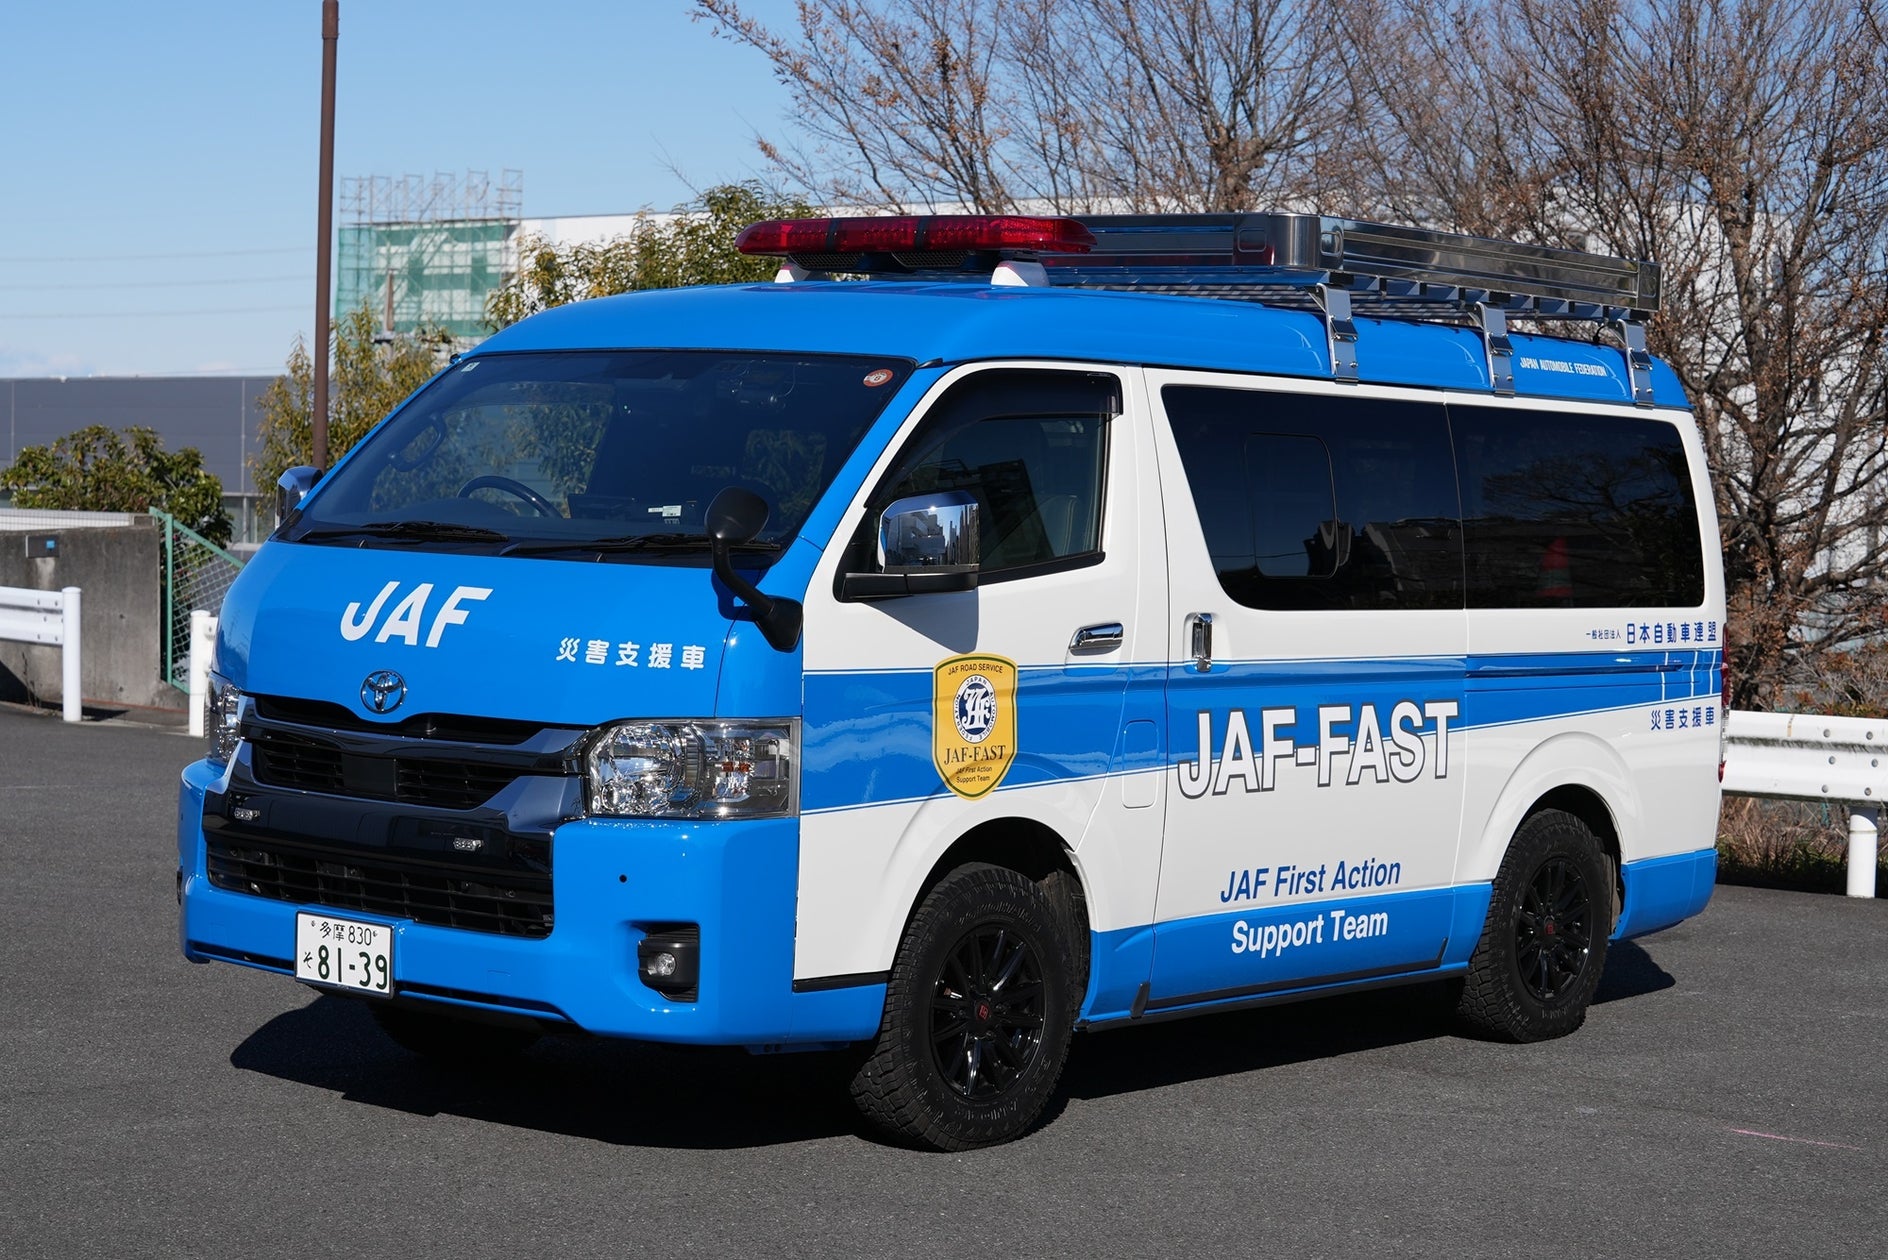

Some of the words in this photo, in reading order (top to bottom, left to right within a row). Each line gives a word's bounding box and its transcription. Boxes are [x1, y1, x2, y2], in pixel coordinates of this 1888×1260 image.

[1520, 357, 1539, 369] JAPAN
[1539, 359, 1574, 374] AUTOMOBILE
[1573, 362, 1607, 377] FEDERATION
[340, 580, 494, 648] JAF
[1626, 621, 1717, 644] 日本自動車連盟
[555, 636, 706, 671] 災害支援車
[948, 665, 959, 676] JAF
[960, 663, 977, 672] ROAD
[978, 663, 1003, 674] SERVICE
[1650, 706, 1715, 731] 災害支援車
[943, 745, 1005, 765] JAF-FAST
[1177, 699, 1459, 799] JAF-FAST
[956, 775, 976, 784] Support
[977, 774, 991, 782] Team
[976, 765, 992, 773] Action
[1220, 867, 1269, 904] JAF
[1273, 863, 1326, 897] First
[1330, 856, 1401, 892] Action
[319, 921, 345, 941] 多摩
[347, 925, 372, 946] 830
[1231, 913, 1325, 959] Support
[1330, 909, 1389, 942] Team
[303, 951, 313, 969] そ
[318, 944, 388, 990] 81-39
